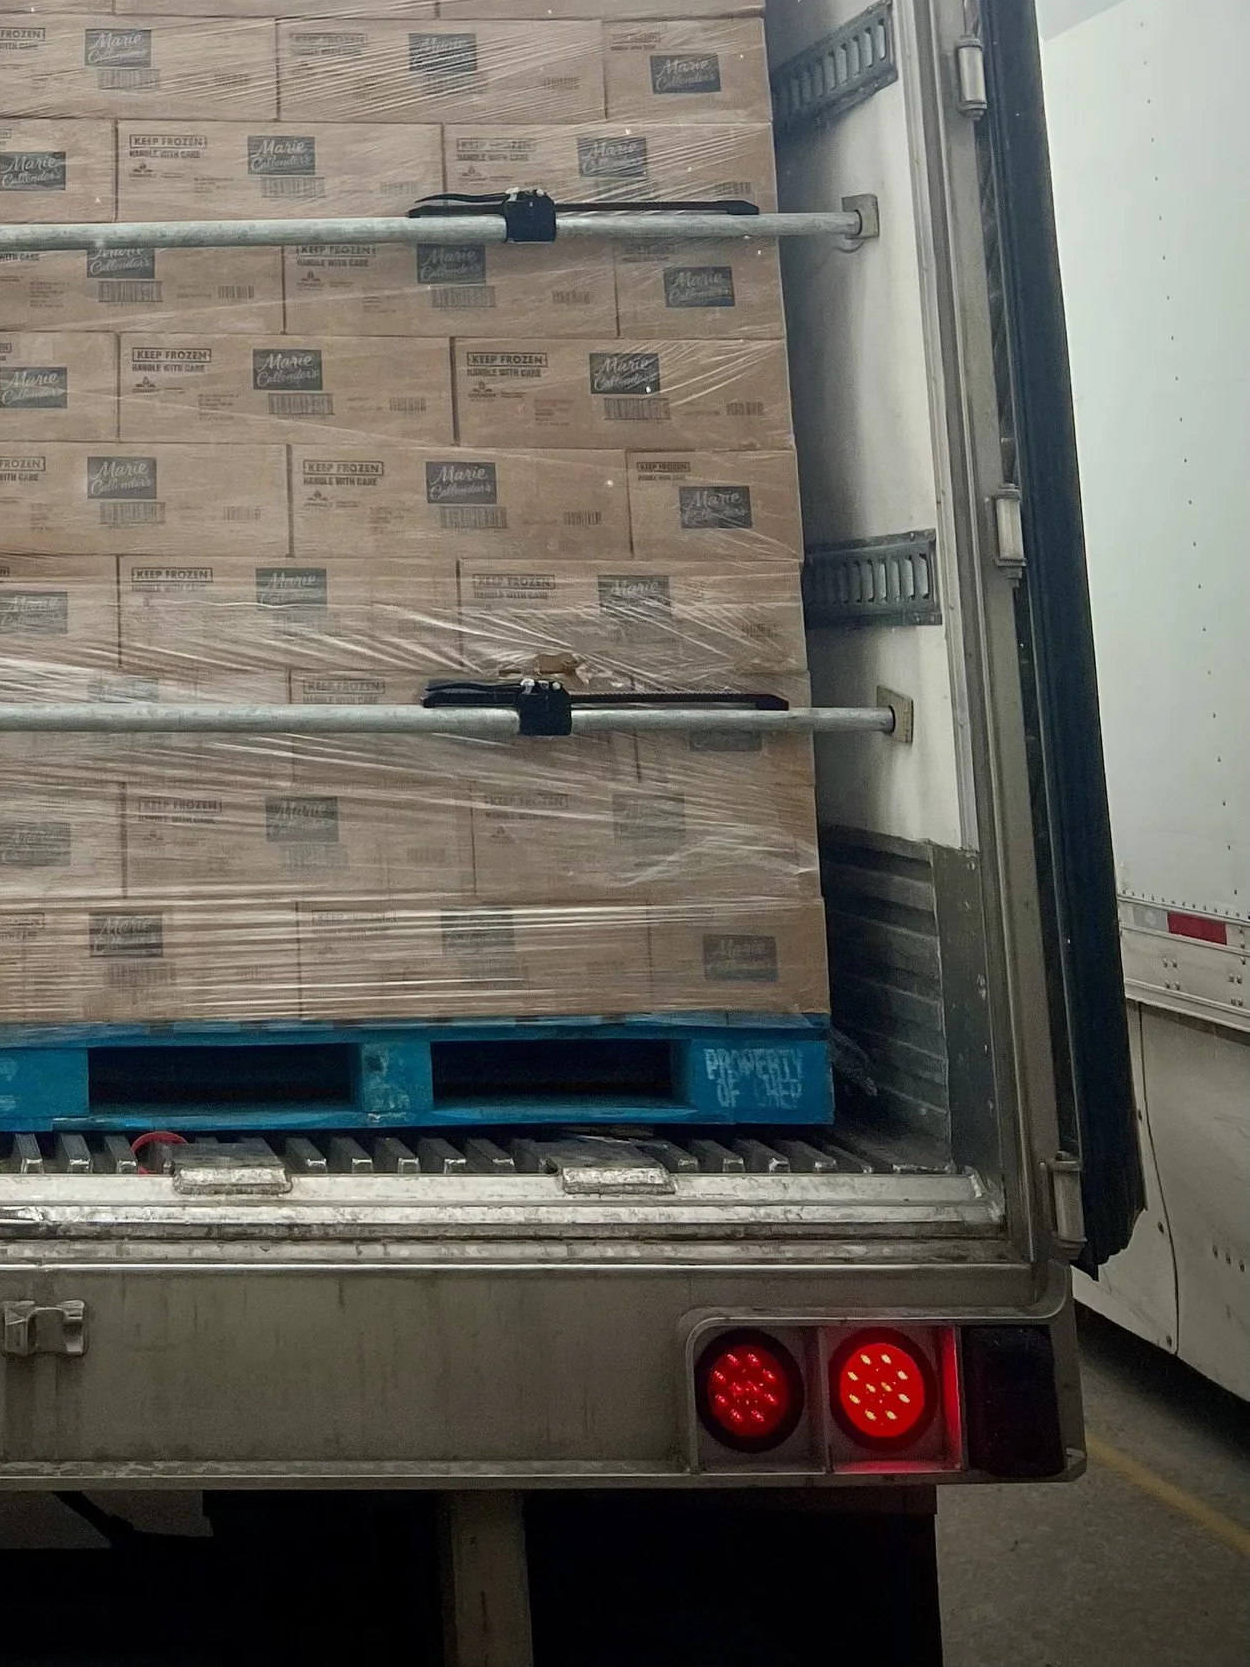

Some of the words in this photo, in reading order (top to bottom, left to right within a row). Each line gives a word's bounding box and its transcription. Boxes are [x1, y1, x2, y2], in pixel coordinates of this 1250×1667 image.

[1, 29, 41, 38] FROZEN
[135, 137, 159, 146] KEEP
[162, 138, 203, 146] FROZEN
[253, 139, 306, 156] Marie
[5, 155, 56, 172] Marie
[301, 246, 326, 254] KEEP
[137, 351, 162, 360] KEEP
[166, 351, 207, 360] FROZEN
[472, 355, 497, 364] KEEP
[501, 355, 542, 364] FROZEN
[264, 354, 312, 372] Marie
[0, 459, 40, 469] FROZEN
[308, 463, 332, 472] KEEP
[337, 464, 378, 473] FROZEN
[96, 463, 148, 480] Marie
[430, 466, 486, 484] Marie
[137, 570, 161, 579] KEEP
[165, 570, 208, 580] FROZEN
[339, 681, 380, 692] FROZEN
